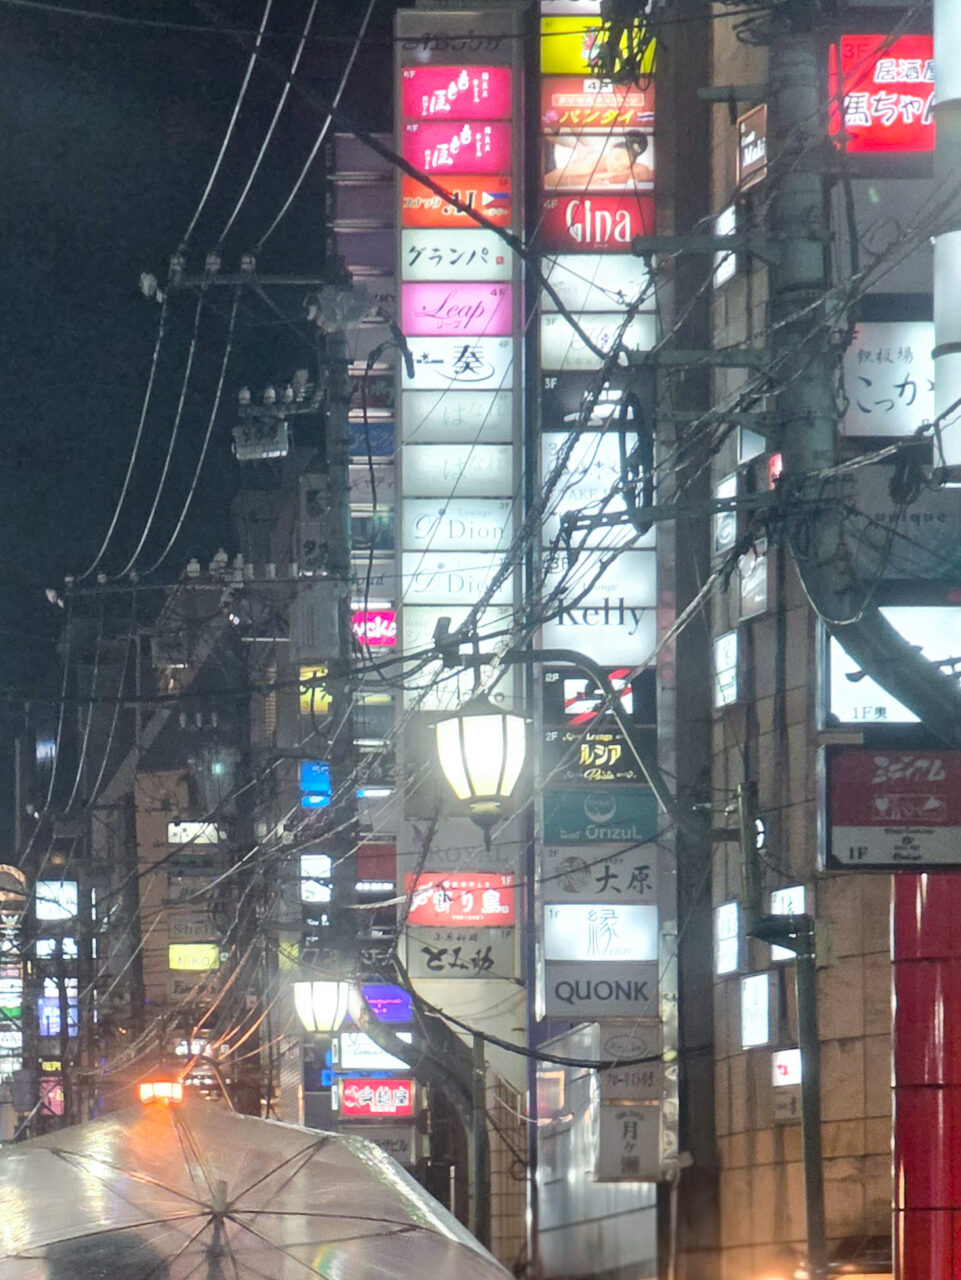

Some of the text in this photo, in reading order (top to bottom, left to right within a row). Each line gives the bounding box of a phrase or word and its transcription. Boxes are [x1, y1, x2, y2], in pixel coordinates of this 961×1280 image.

[560, 108, 635, 125] パンタイ
[408, 245, 489, 267] グランパ
[557, 596, 646, 636] Kelly
[579, 744, 622, 766] ルシア
[595, 865, 652, 895] 大原
[555, 980, 650, 1004] QUONK
